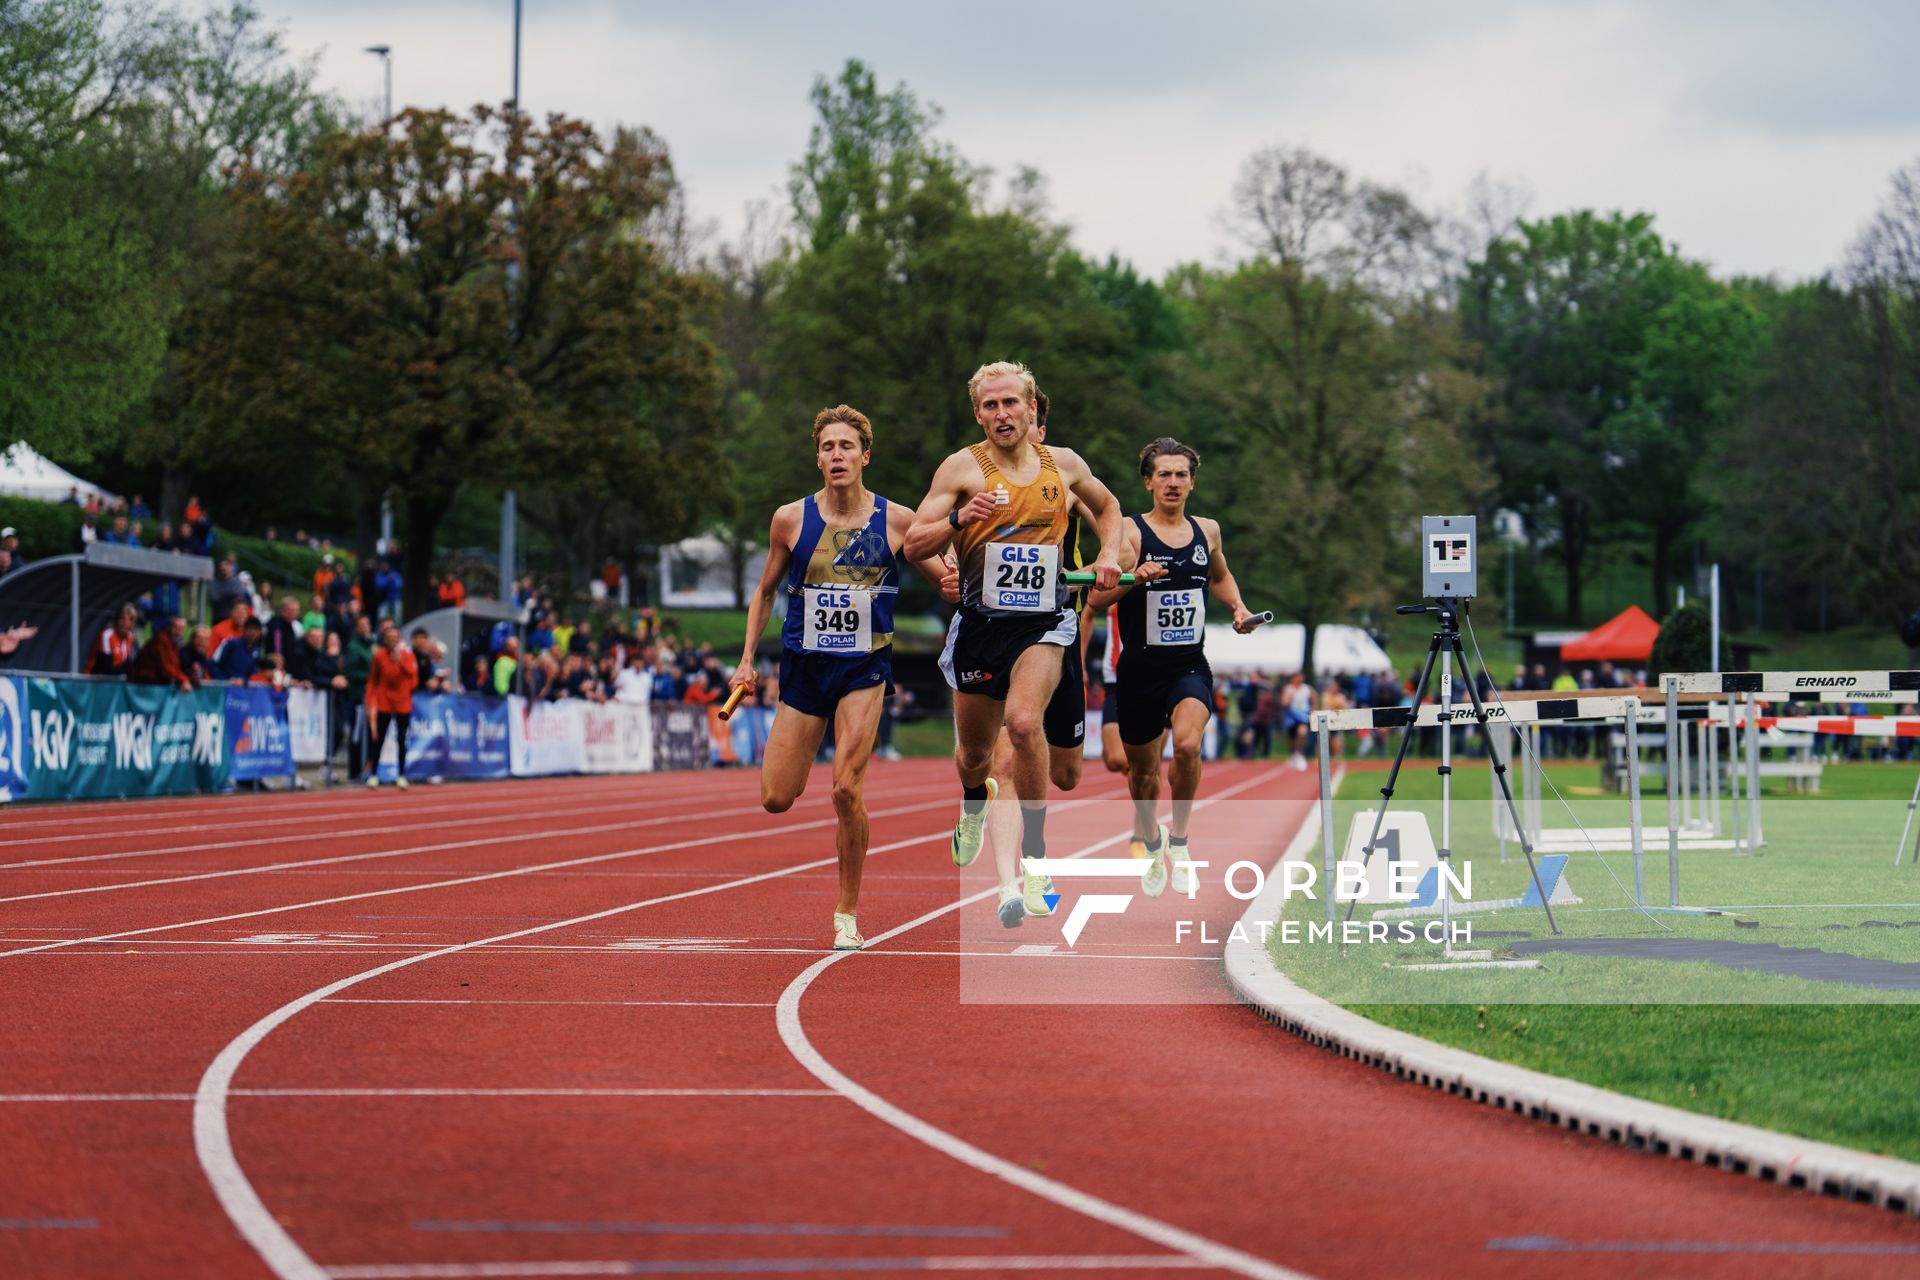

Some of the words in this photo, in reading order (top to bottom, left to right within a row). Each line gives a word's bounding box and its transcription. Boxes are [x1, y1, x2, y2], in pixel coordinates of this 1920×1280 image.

[996, 564, 1046, 590] 248
[1016, 594, 1039, 602] PLAN
[814, 609, 859, 632] 349
[1157, 607, 1196, 628] 587
[832, 636, 854, 644] PLAN
[1175, 630, 1193, 638] PLAN
[961, 669, 982, 681] LSC
[1795, 677, 1857, 687] ERHARD
[1449, 707, 1506, 719] ERHRD
